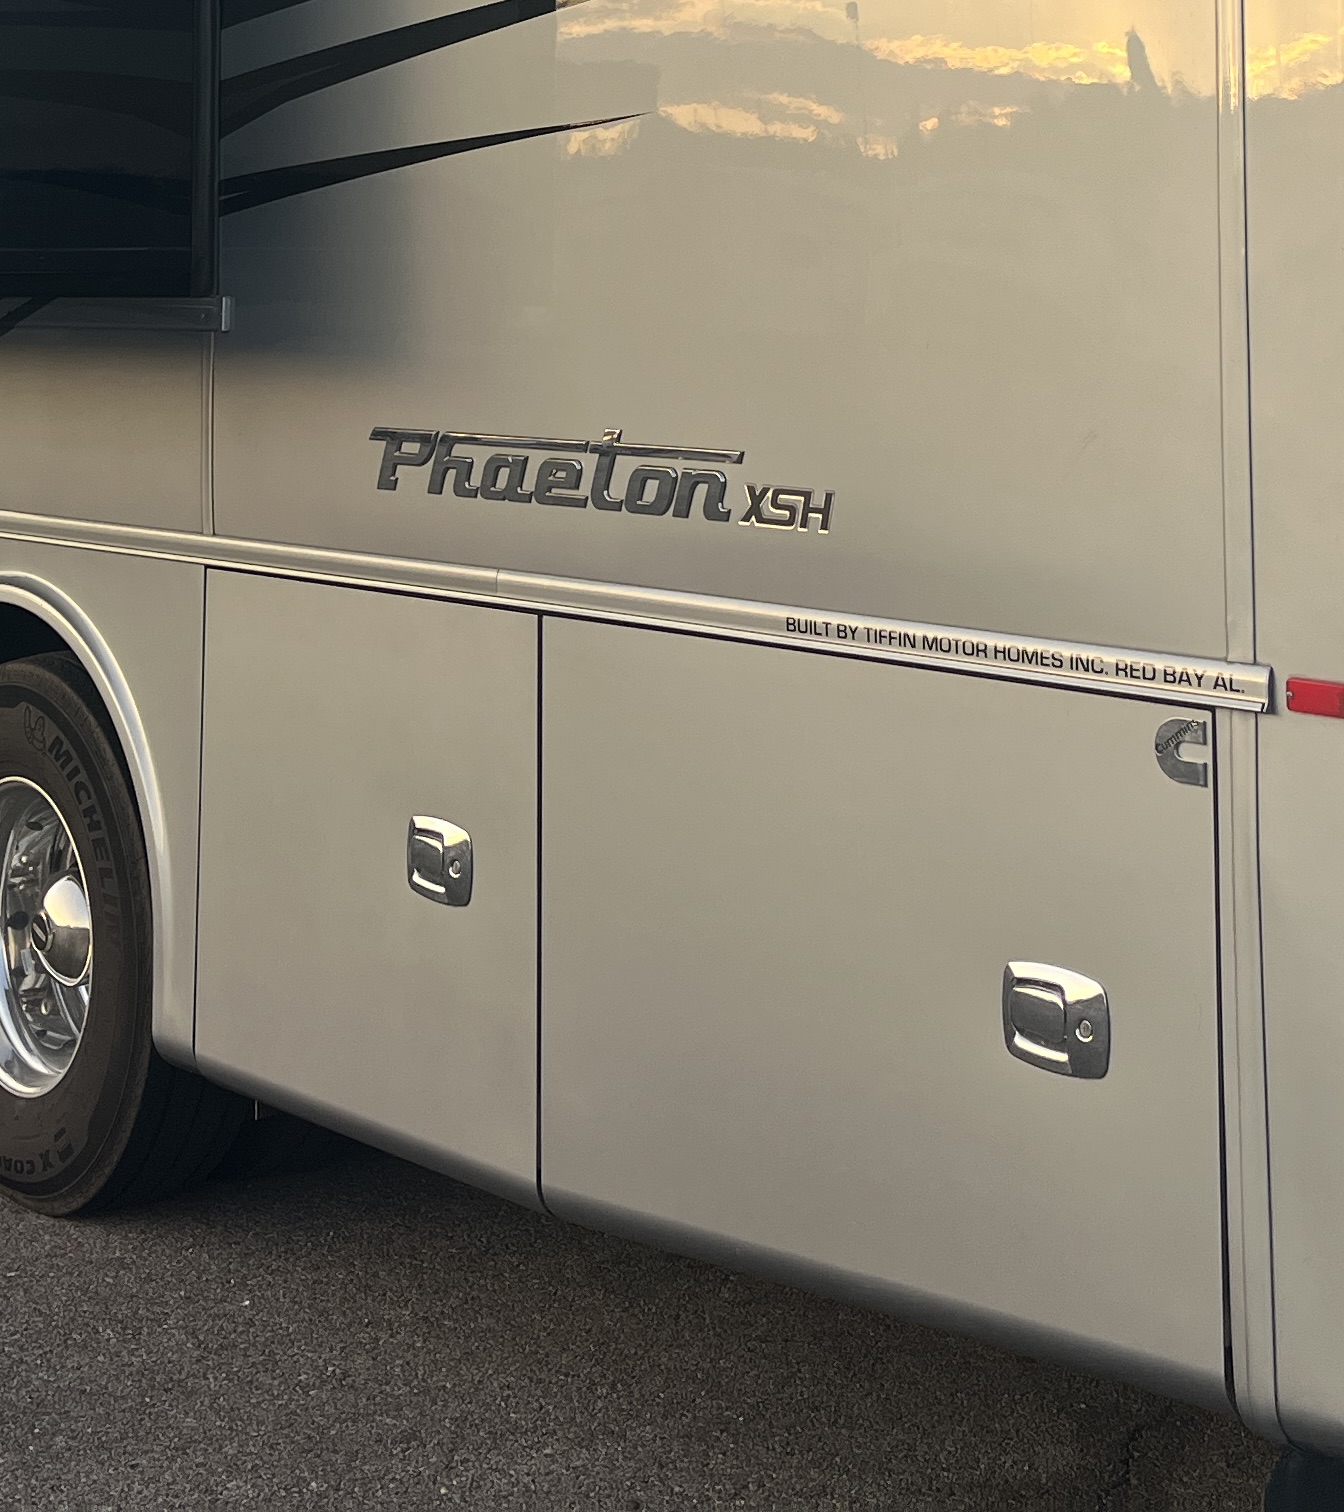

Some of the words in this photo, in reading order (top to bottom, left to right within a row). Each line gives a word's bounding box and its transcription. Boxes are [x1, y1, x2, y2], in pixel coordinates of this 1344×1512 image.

[368, 426, 746, 523] Phaeton
[736, 482, 836, 535] XSH
[785, 616, 832, 638] BUILT
[836, 623, 859, 641] BY
[864, 627, 917, 649] TIFFIN
[922, 634, 988, 659] MOTOR
[993, 643, 1064, 669] HOMES
[1069, 652, 1109, 676] INC.
[1115, 659, 1157, 682] RED
[1163, 665, 1207, 689] BAY
[1212, 672, 1246, 694] AL.
[1155, 719, 1200, 755] Cummins
[47, 735, 121, 935] MICHELIN
